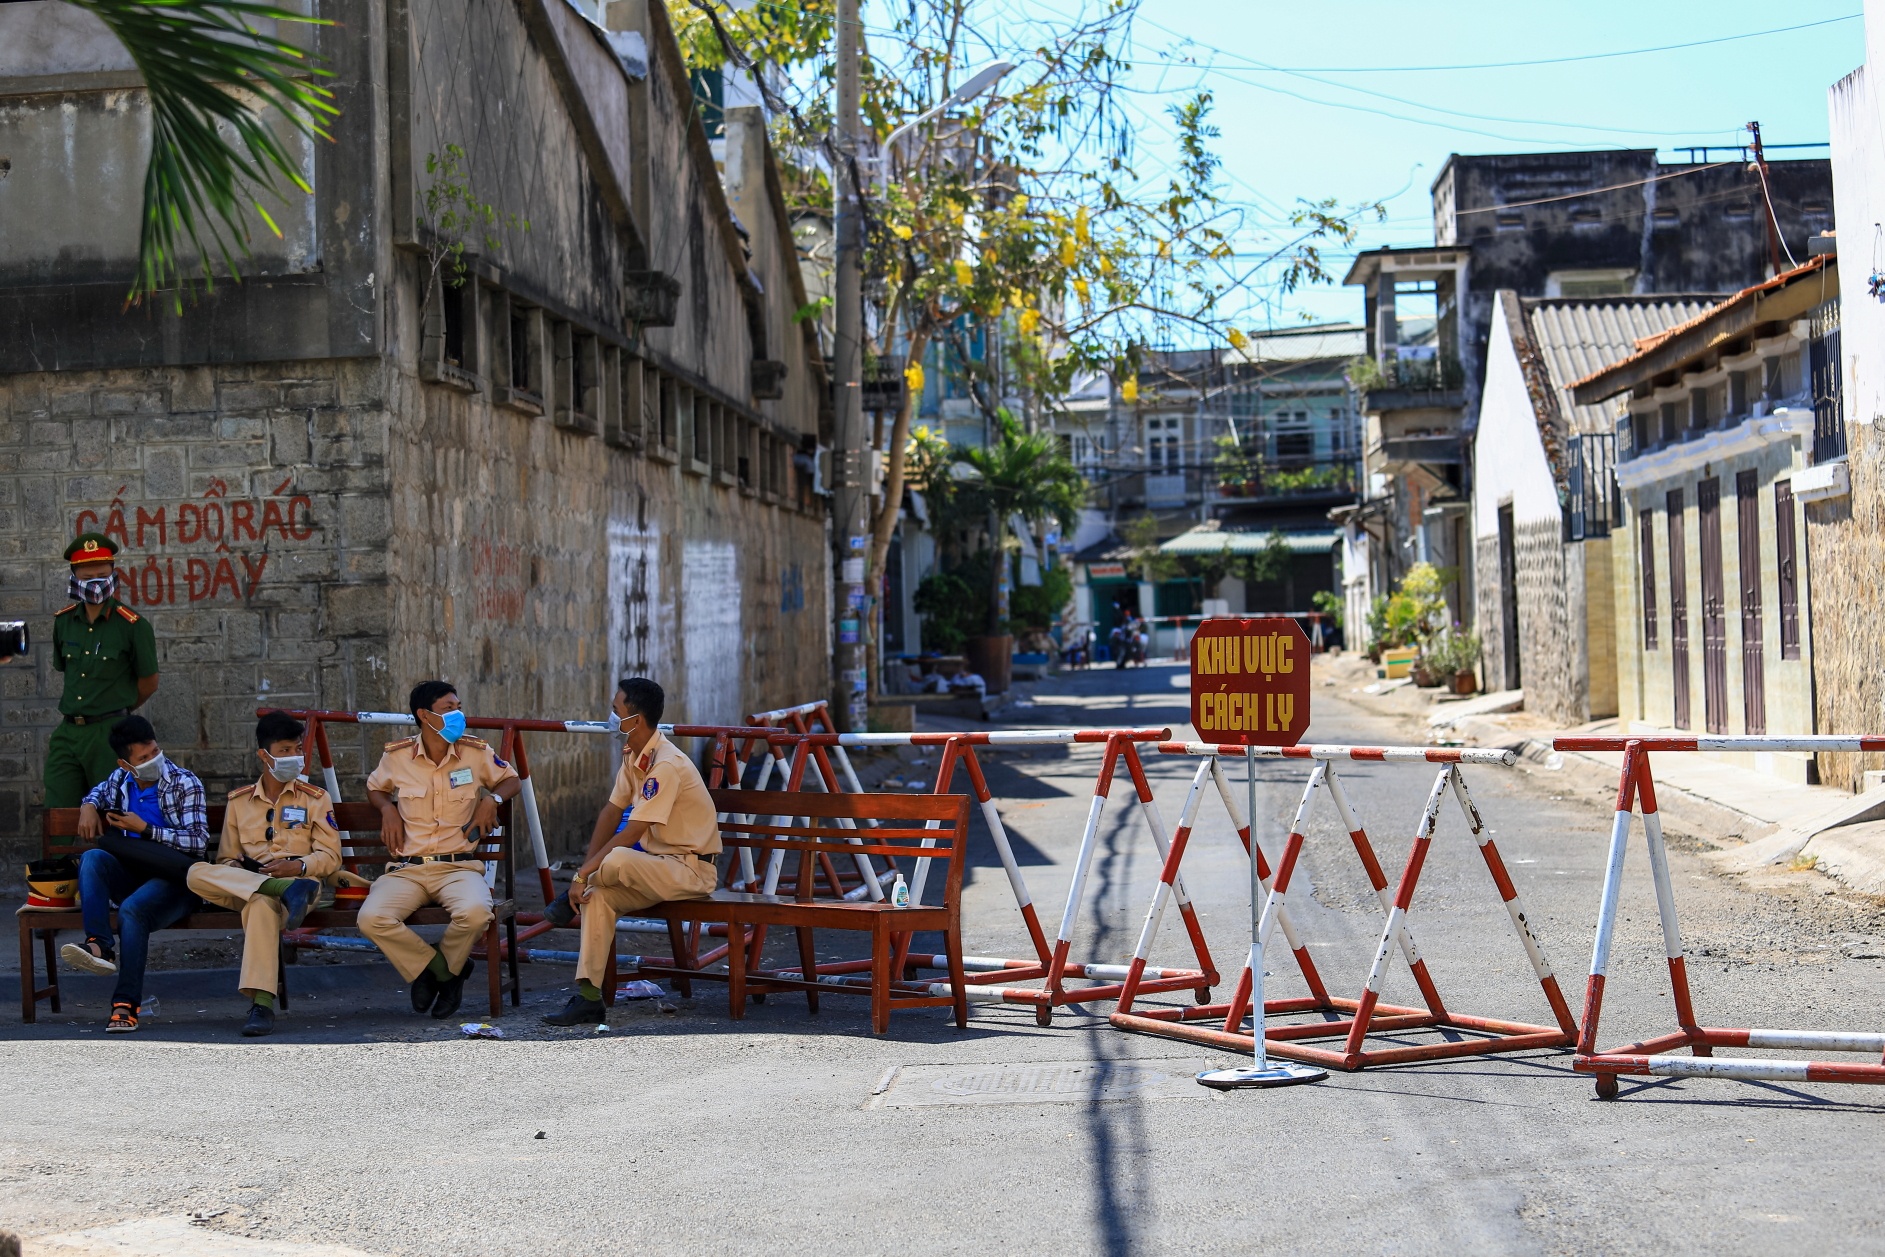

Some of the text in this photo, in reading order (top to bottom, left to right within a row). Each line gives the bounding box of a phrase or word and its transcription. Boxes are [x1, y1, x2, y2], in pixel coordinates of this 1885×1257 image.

[174, 475, 228, 544] ĐỔ
[232, 477, 313, 542] RÁC
[183, 543, 268, 602] ĐÂY
[1197, 632, 1294, 682] KHU VỰC
[1199, 683, 1294, 732] CÁCH LY
